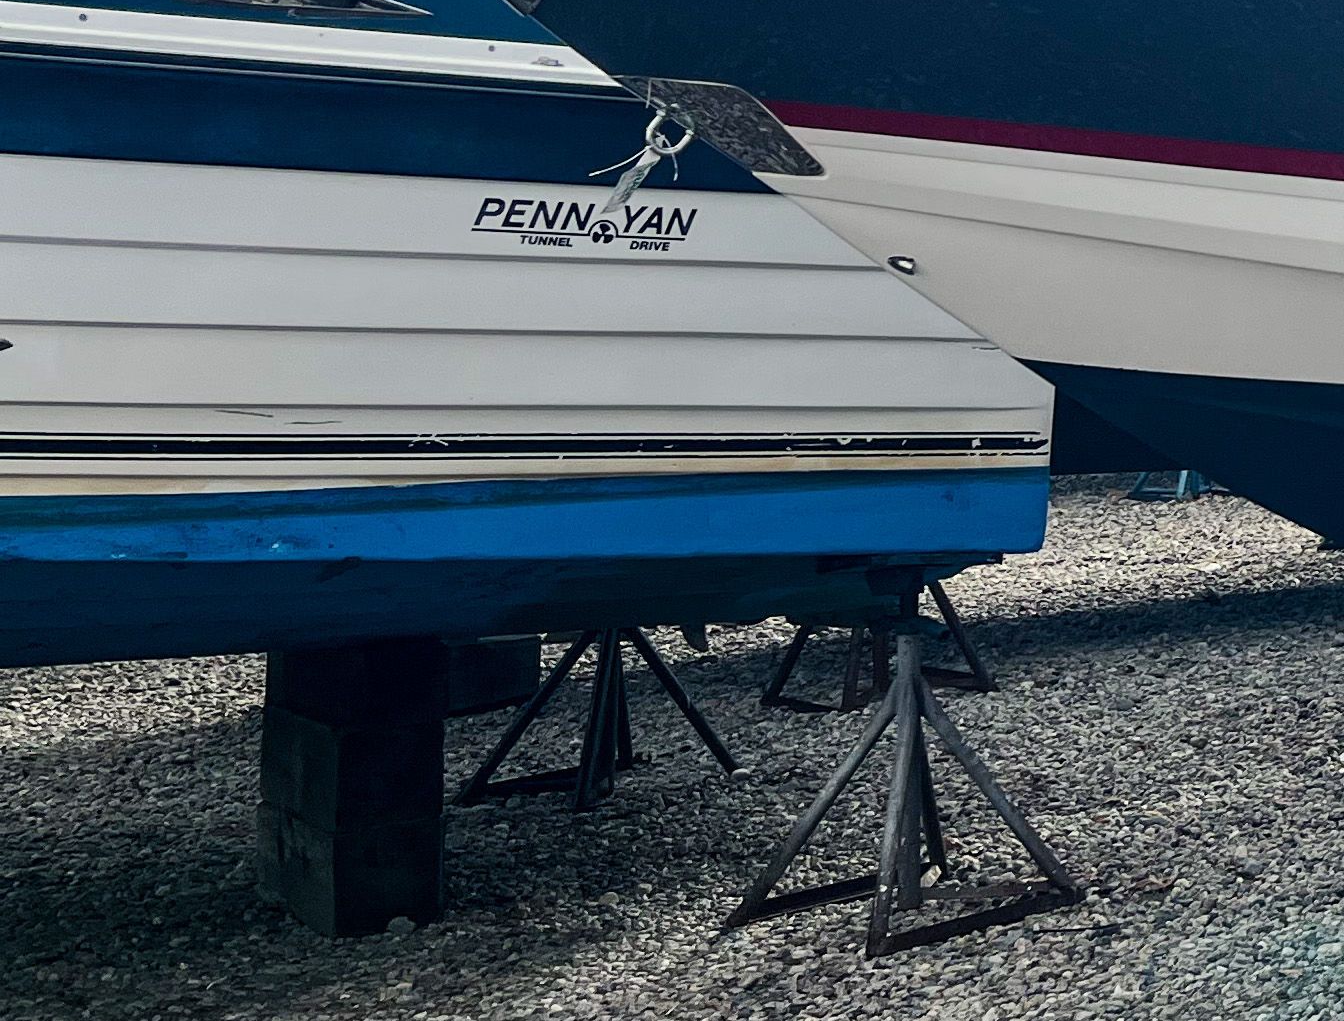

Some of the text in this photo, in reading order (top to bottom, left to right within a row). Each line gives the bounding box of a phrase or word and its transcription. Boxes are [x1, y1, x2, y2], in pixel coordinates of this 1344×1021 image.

[474, 197, 698, 236] PENN YAN
[519, 235, 670, 252] TUNNEL DRIVE
